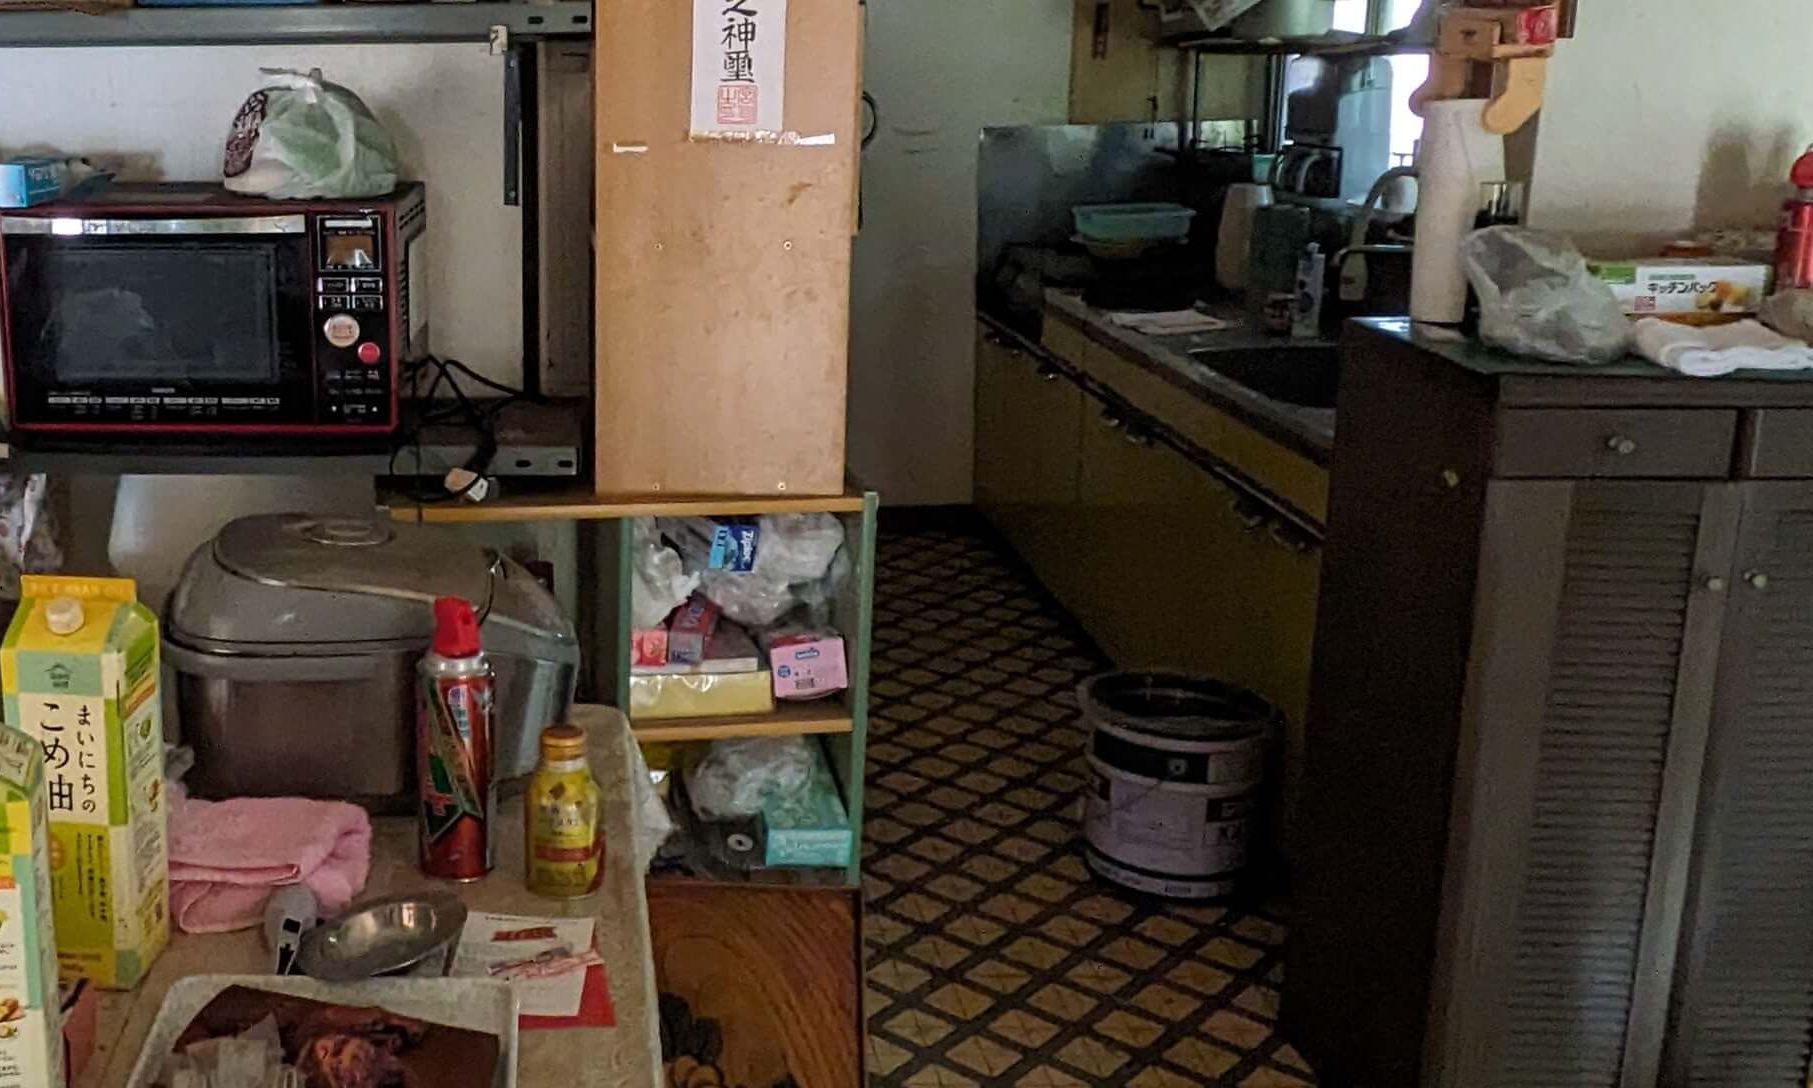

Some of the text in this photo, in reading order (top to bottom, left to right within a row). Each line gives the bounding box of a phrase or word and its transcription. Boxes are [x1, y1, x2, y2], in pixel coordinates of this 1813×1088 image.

[1647, 281, 1719, 295] キッチンパック
[76, 704, 97, 813] まいにちの
